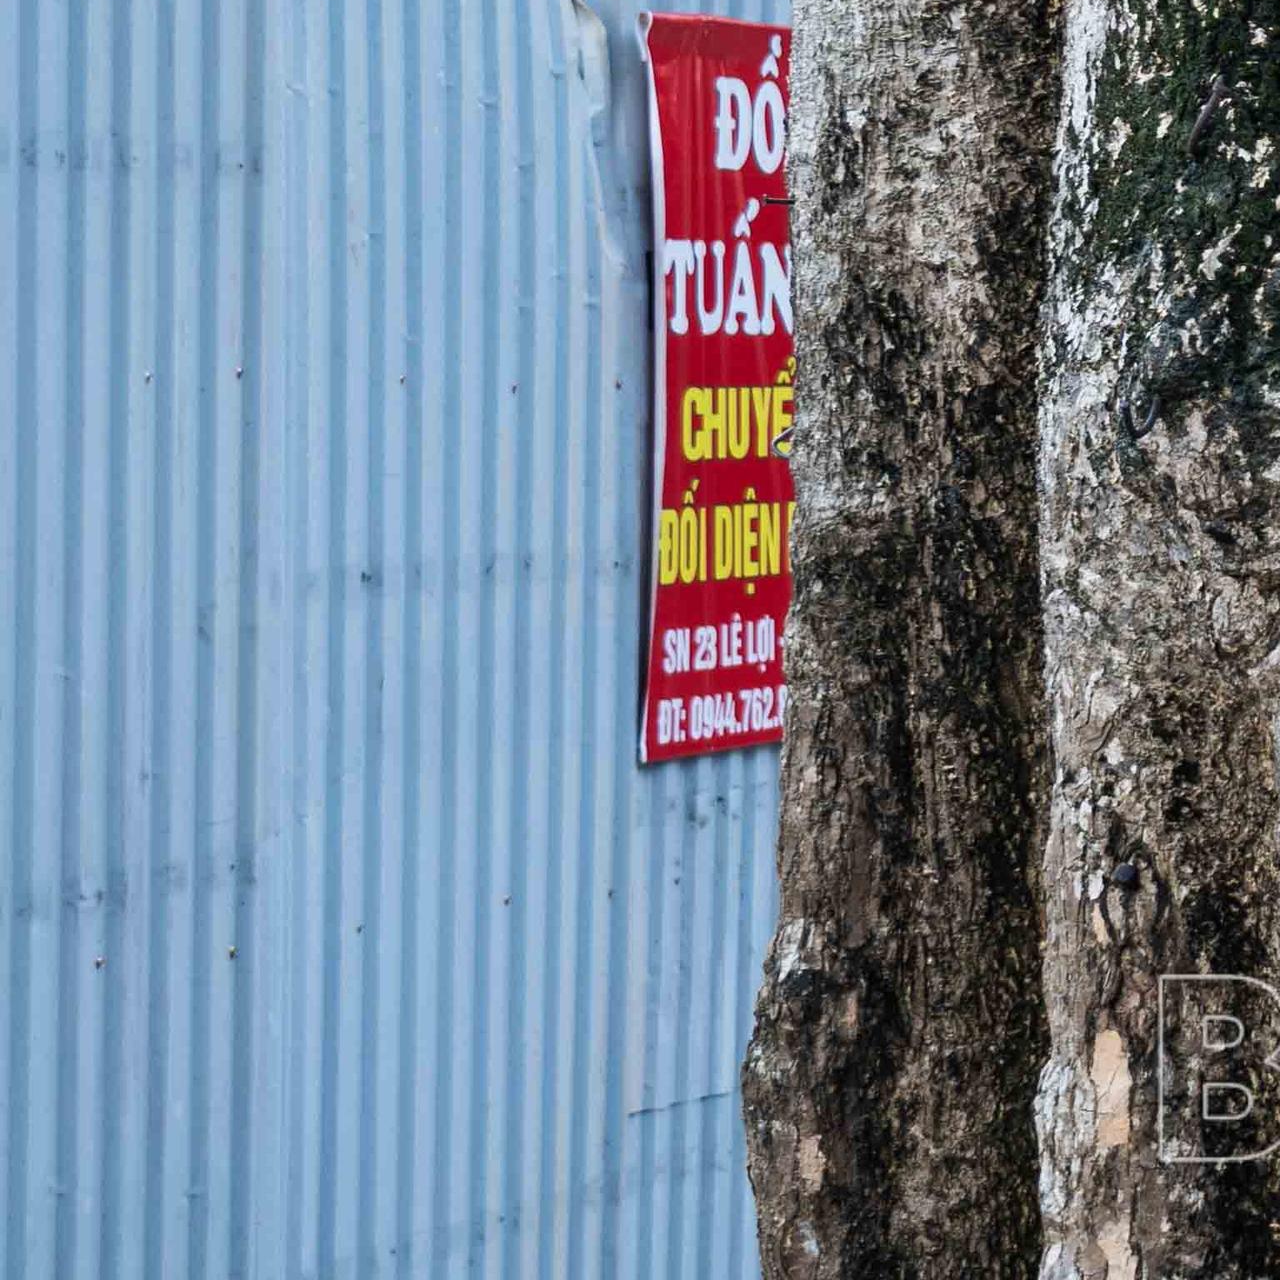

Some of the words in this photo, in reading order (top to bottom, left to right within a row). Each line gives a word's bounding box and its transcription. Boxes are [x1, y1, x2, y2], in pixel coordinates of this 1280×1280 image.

[715, 33, 788, 175] ĐỒ
[664, 197, 793, 336] TUẤN
[659, 479, 707, 585] ĐỐI
[715, 487, 781, 595] DIỆN
[662, 627, 691, 674] SN
[720, 612, 743, 667] LÊ
[746, 613, 775, 673] LỢI
[657, 697, 687, 745] ĐT:
